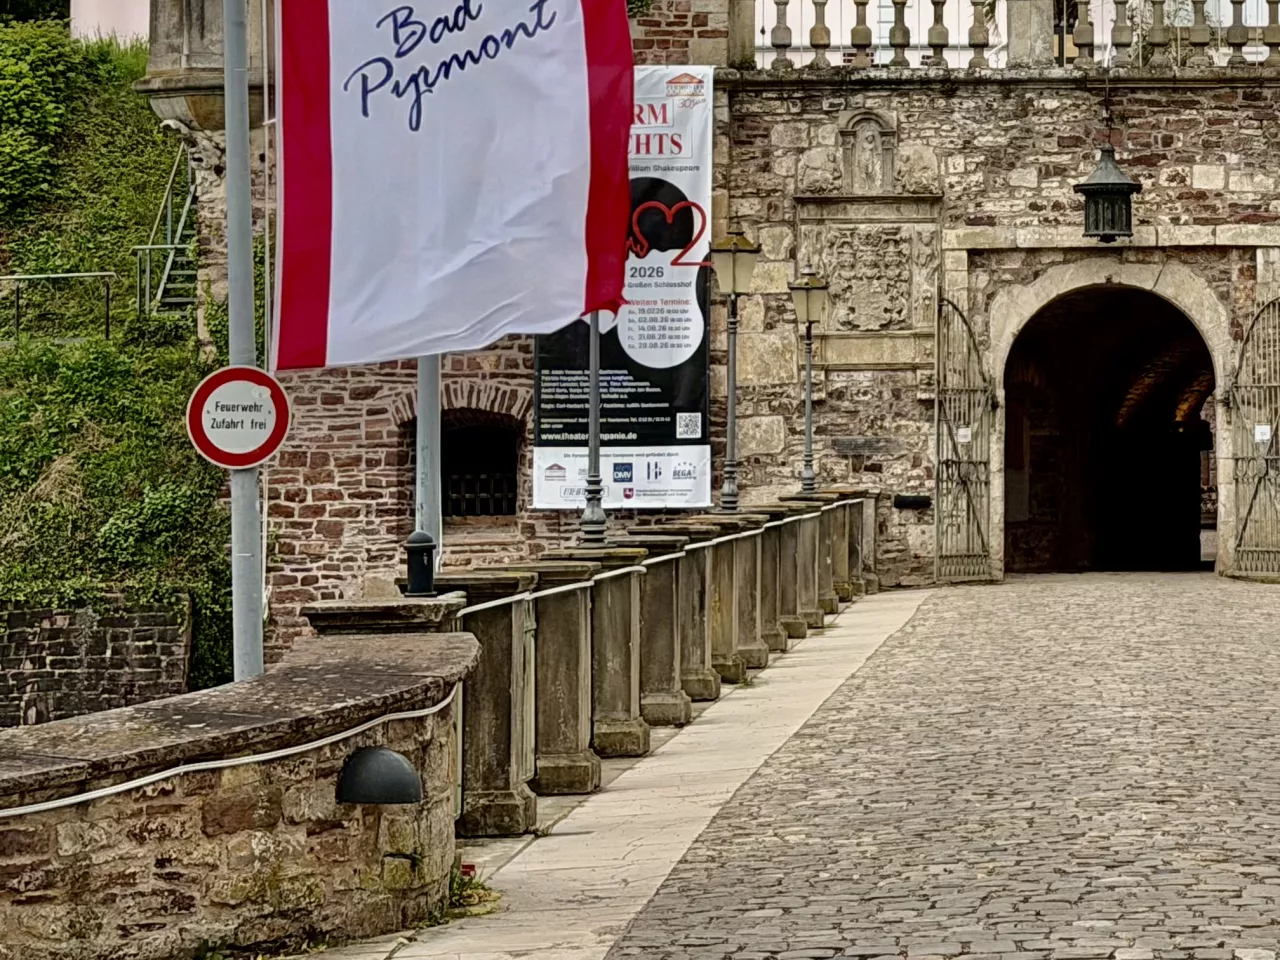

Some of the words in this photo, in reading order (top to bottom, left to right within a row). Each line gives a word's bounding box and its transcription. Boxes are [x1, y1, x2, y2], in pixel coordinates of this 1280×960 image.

[633, 103, 668, 125] RM
[630, 267, 664, 278] 2026
[215, 401, 263, 413] Feuerwehr
[210, 418, 244, 429] Zufahrt
[250, 418, 267, 430] frei
